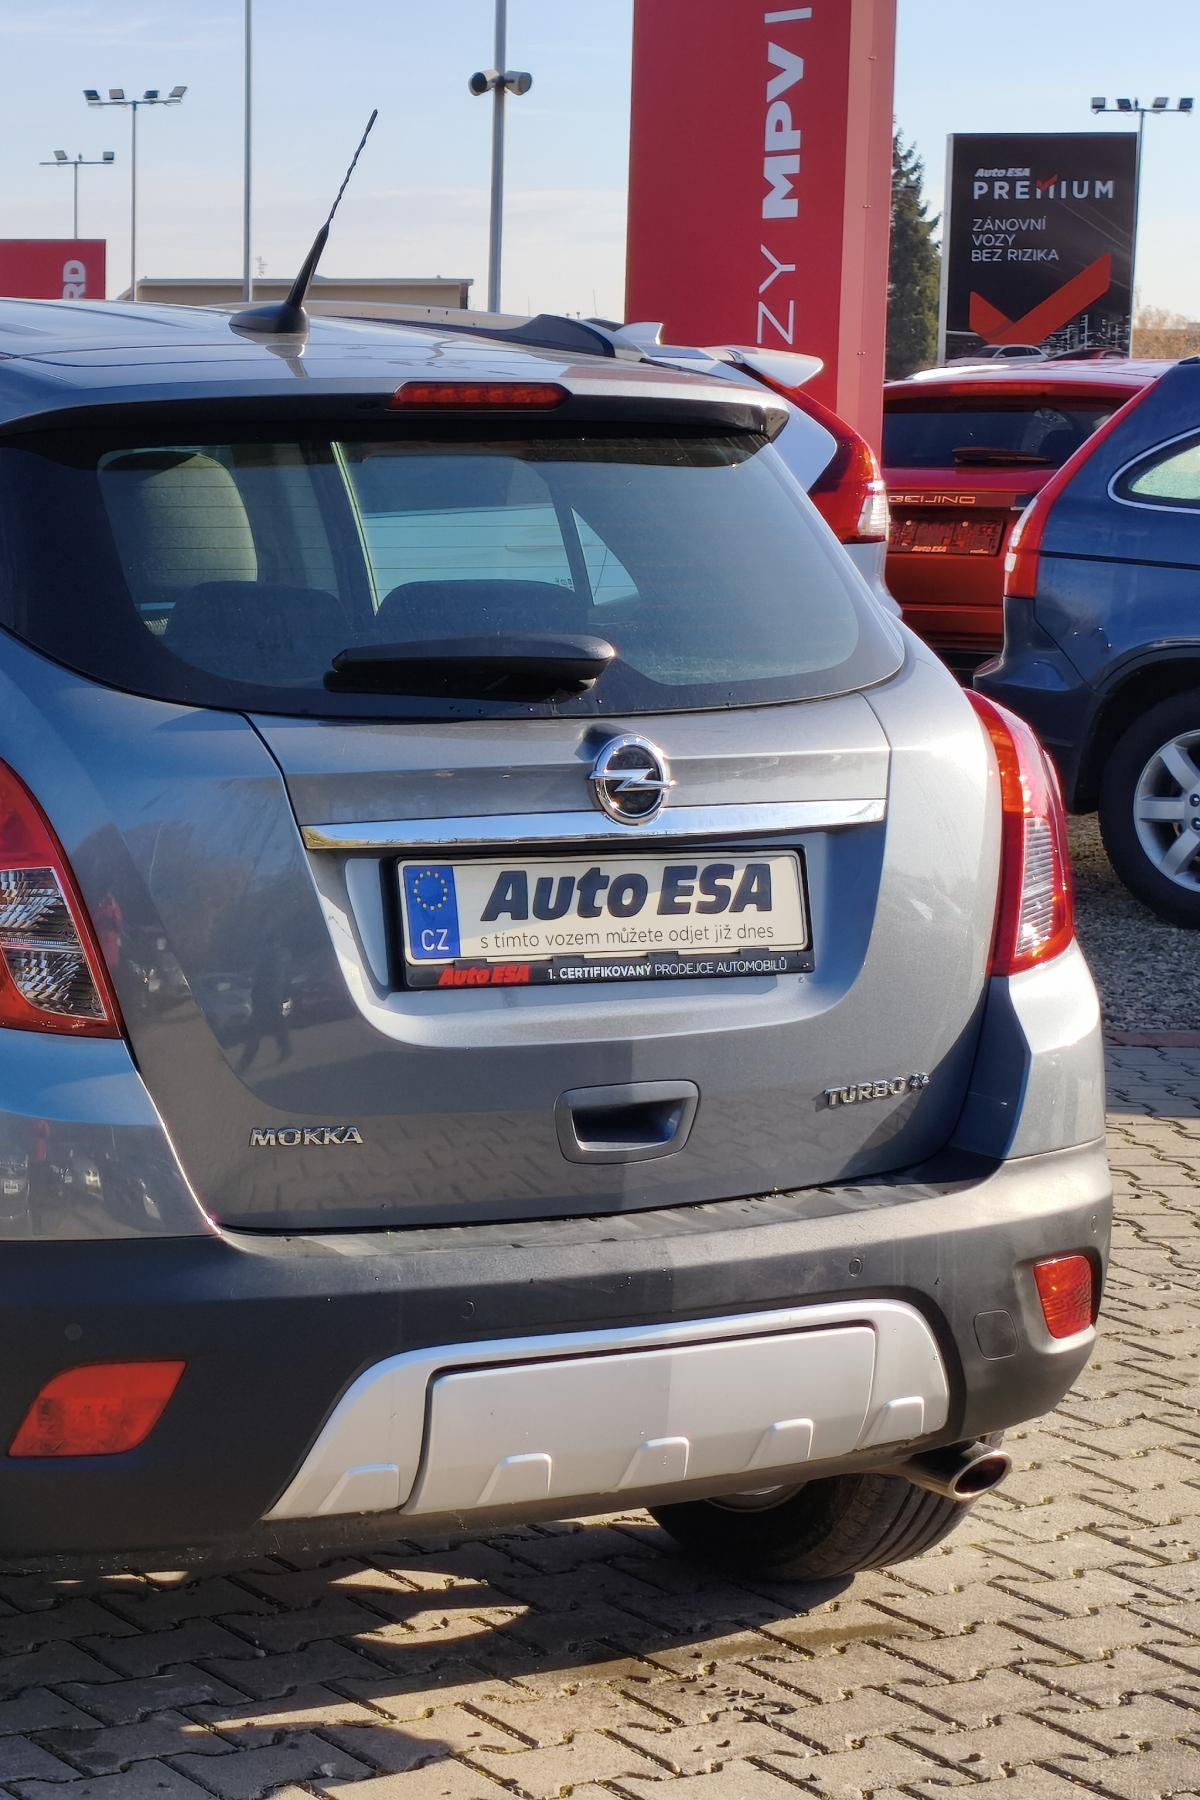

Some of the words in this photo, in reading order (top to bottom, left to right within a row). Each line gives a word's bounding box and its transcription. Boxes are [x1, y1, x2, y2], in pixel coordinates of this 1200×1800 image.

[762, 41, 805, 219] MPV
[974, 168, 1005, 177] Auto
[1006, 168, 1031, 177] ESA
[973, 176, 1114, 200] PREMIUM
[972, 216, 1047, 232] ZÁNOVNÍ
[971, 234, 1016, 246] VOZY
[971, 249, 1002, 262] BEZ
[1007, 249, 1060, 262] RIZIKA
[756, 244, 796, 344] ZY
[888, 495, 977, 504] BEIJING
[480, 867, 648, 922] Auto
[657, 863, 772, 916] ESA
[421, 928, 450, 951] CZ
[480, 936, 489, 949] s
[495, 931, 540, 948] tímto
[545, 932, 600, 947] vozem
[606, 927, 663, 944] můžete
[668, 925, 710, 945] odjet
[714, 924, 732, 943] již
[737, 923, 774, 940] dnes
[438, 967, 490, 987] Auto
[491, 965, 530, 985] ESA
[547, 968, 556, 980] 1.
[559, 962, 652, 979] CERTIFIKOVANÝ
[655, 962, 714, 975] PRODEJCE
[716, 957, 787, 973] AUTOMOBILŮ
[824, 1076, 906, 1106] TURBO
[249, 1127, 364, 1146] MOKKA
